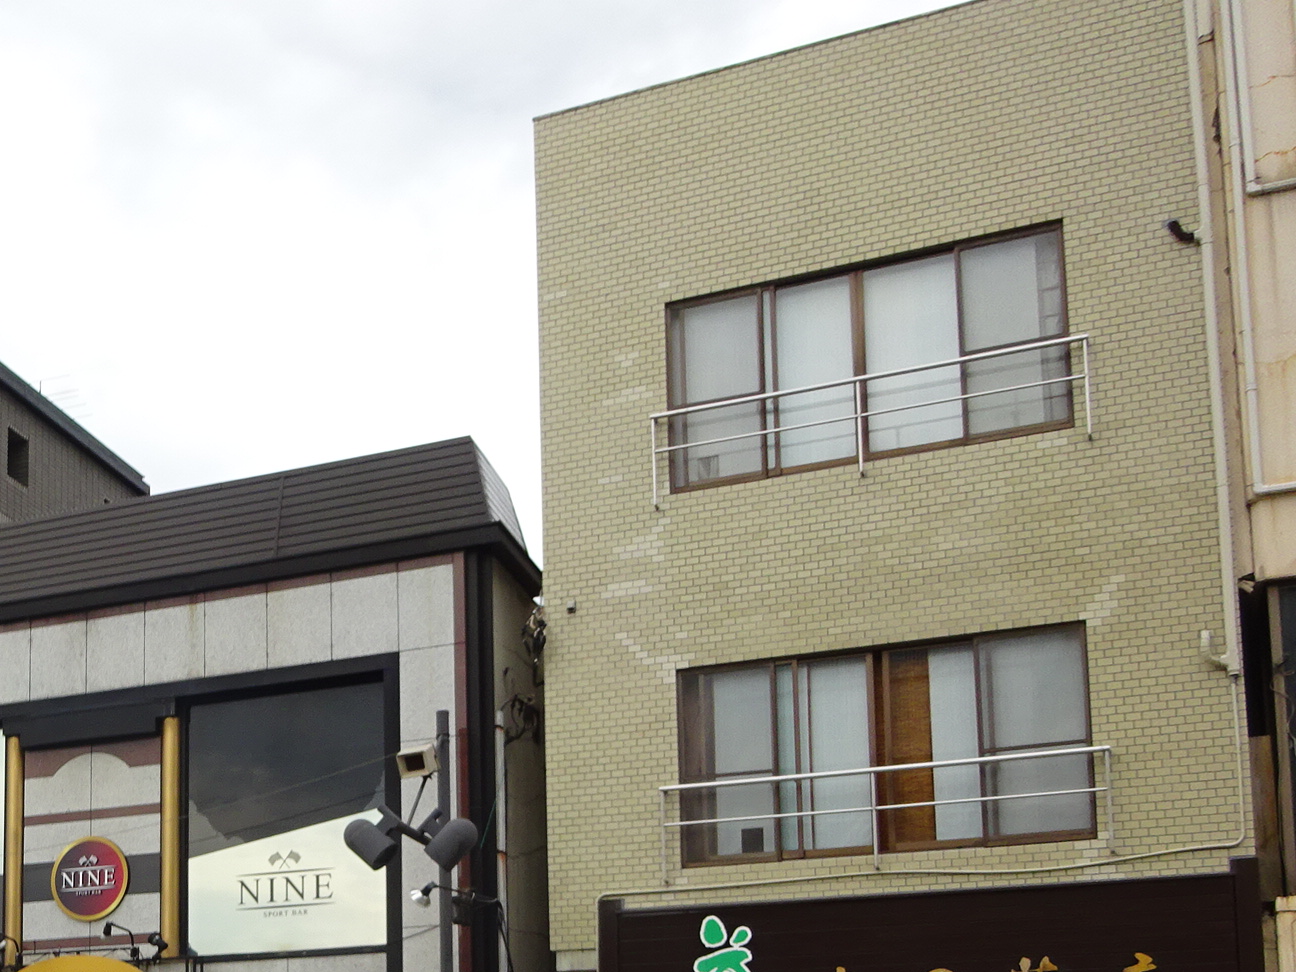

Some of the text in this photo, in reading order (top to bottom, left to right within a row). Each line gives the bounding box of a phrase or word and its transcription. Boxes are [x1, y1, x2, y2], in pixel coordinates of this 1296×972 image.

[61, 868, 116, 889] NINE
[237, 873, 333, 905] NINE
[263, 910, 289, 918] SPORT
